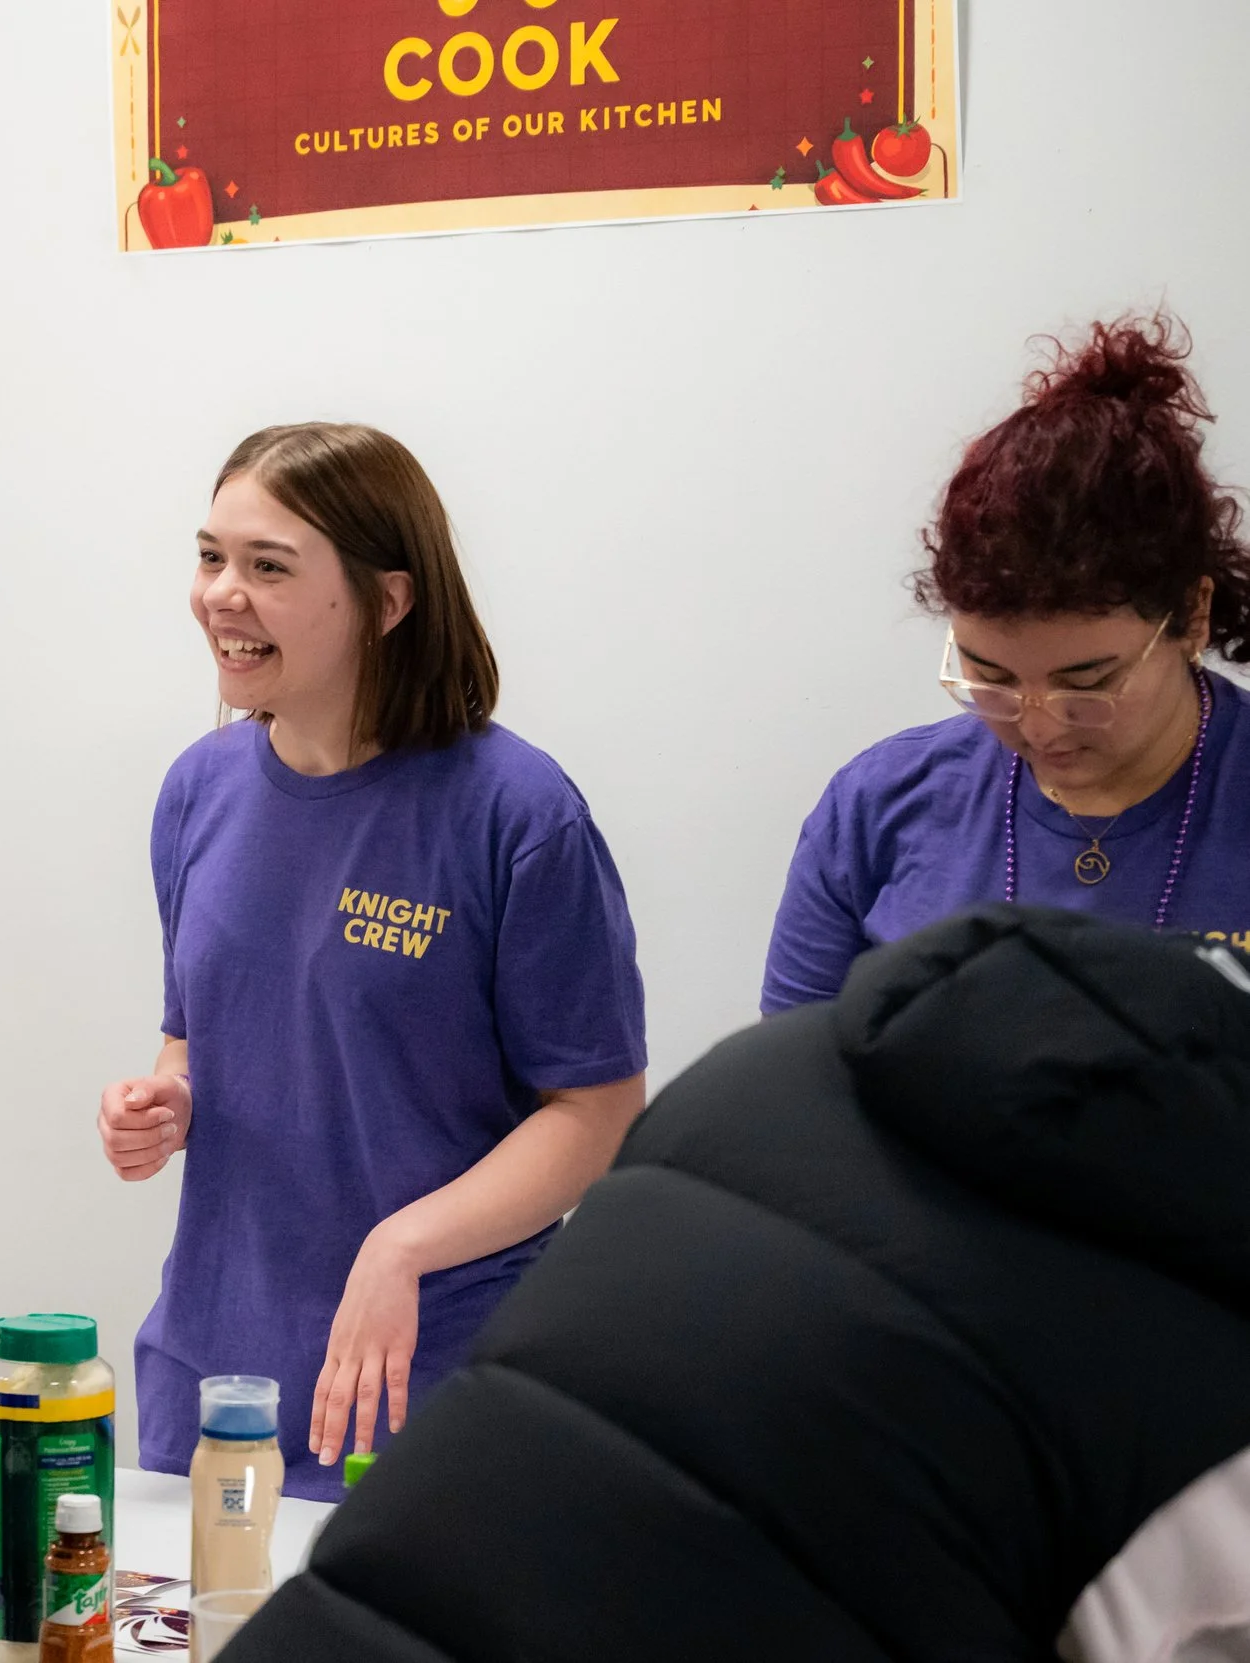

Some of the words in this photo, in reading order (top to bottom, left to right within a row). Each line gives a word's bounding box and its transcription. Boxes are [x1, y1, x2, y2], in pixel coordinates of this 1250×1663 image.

[383, 18, 621, 101] COOK
[294, 121, 440, 155] CULTURES
[452, 117, 491, 143] OF
[502, 111, 565, 138] OUR
[579, 97, 723, 133] KITCHEN
[337, 887, 452, 935] KNIGHT
[343, 918, 433, 960] CREW
